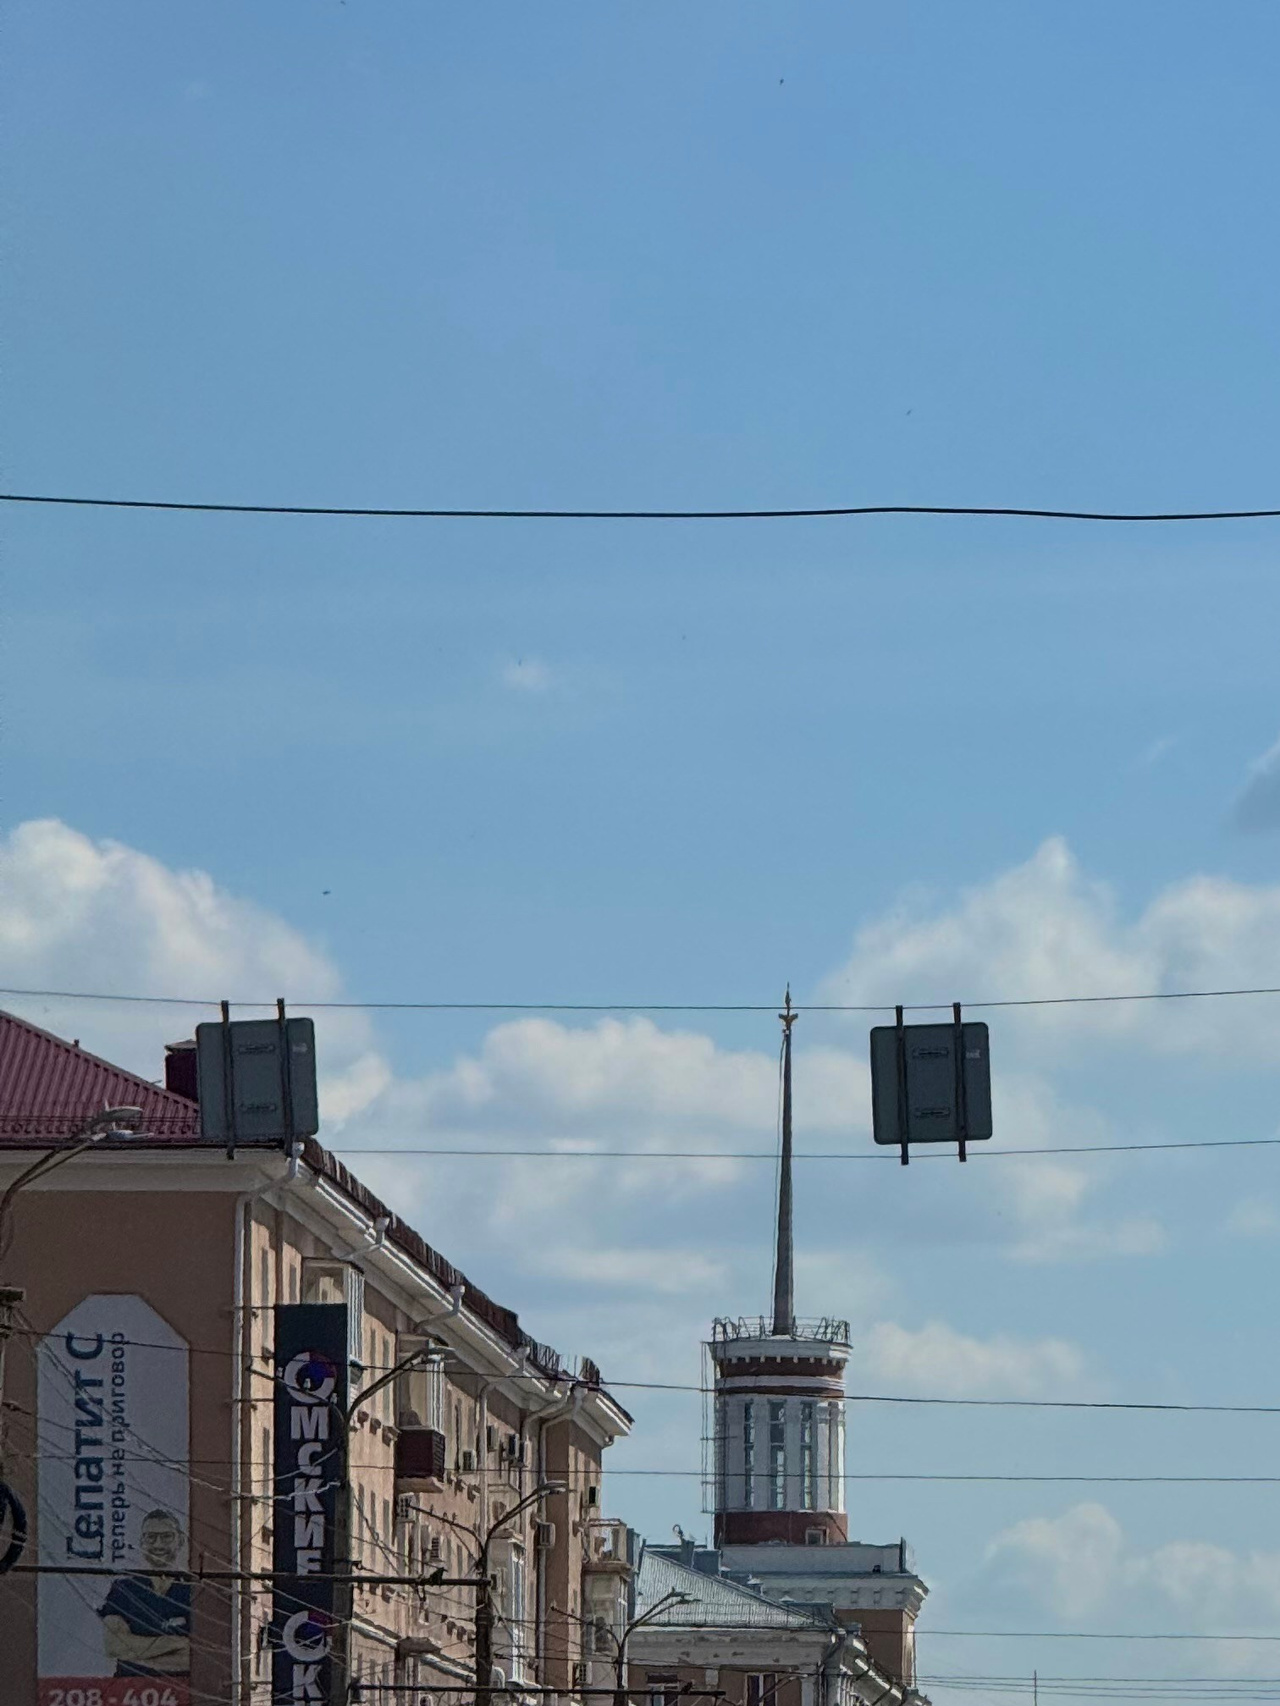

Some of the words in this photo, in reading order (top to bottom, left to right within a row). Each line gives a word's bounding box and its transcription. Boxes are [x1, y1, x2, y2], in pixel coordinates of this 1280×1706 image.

[112, 1331, 130, 1443] приговор
[66, 1368, 104, 1562] Гепатит
[112, 1448, 125, 1477] не
[284, 1351, 337, 1582] ОМСКИЕ
[112, 1479, 130, 1563] теперь
